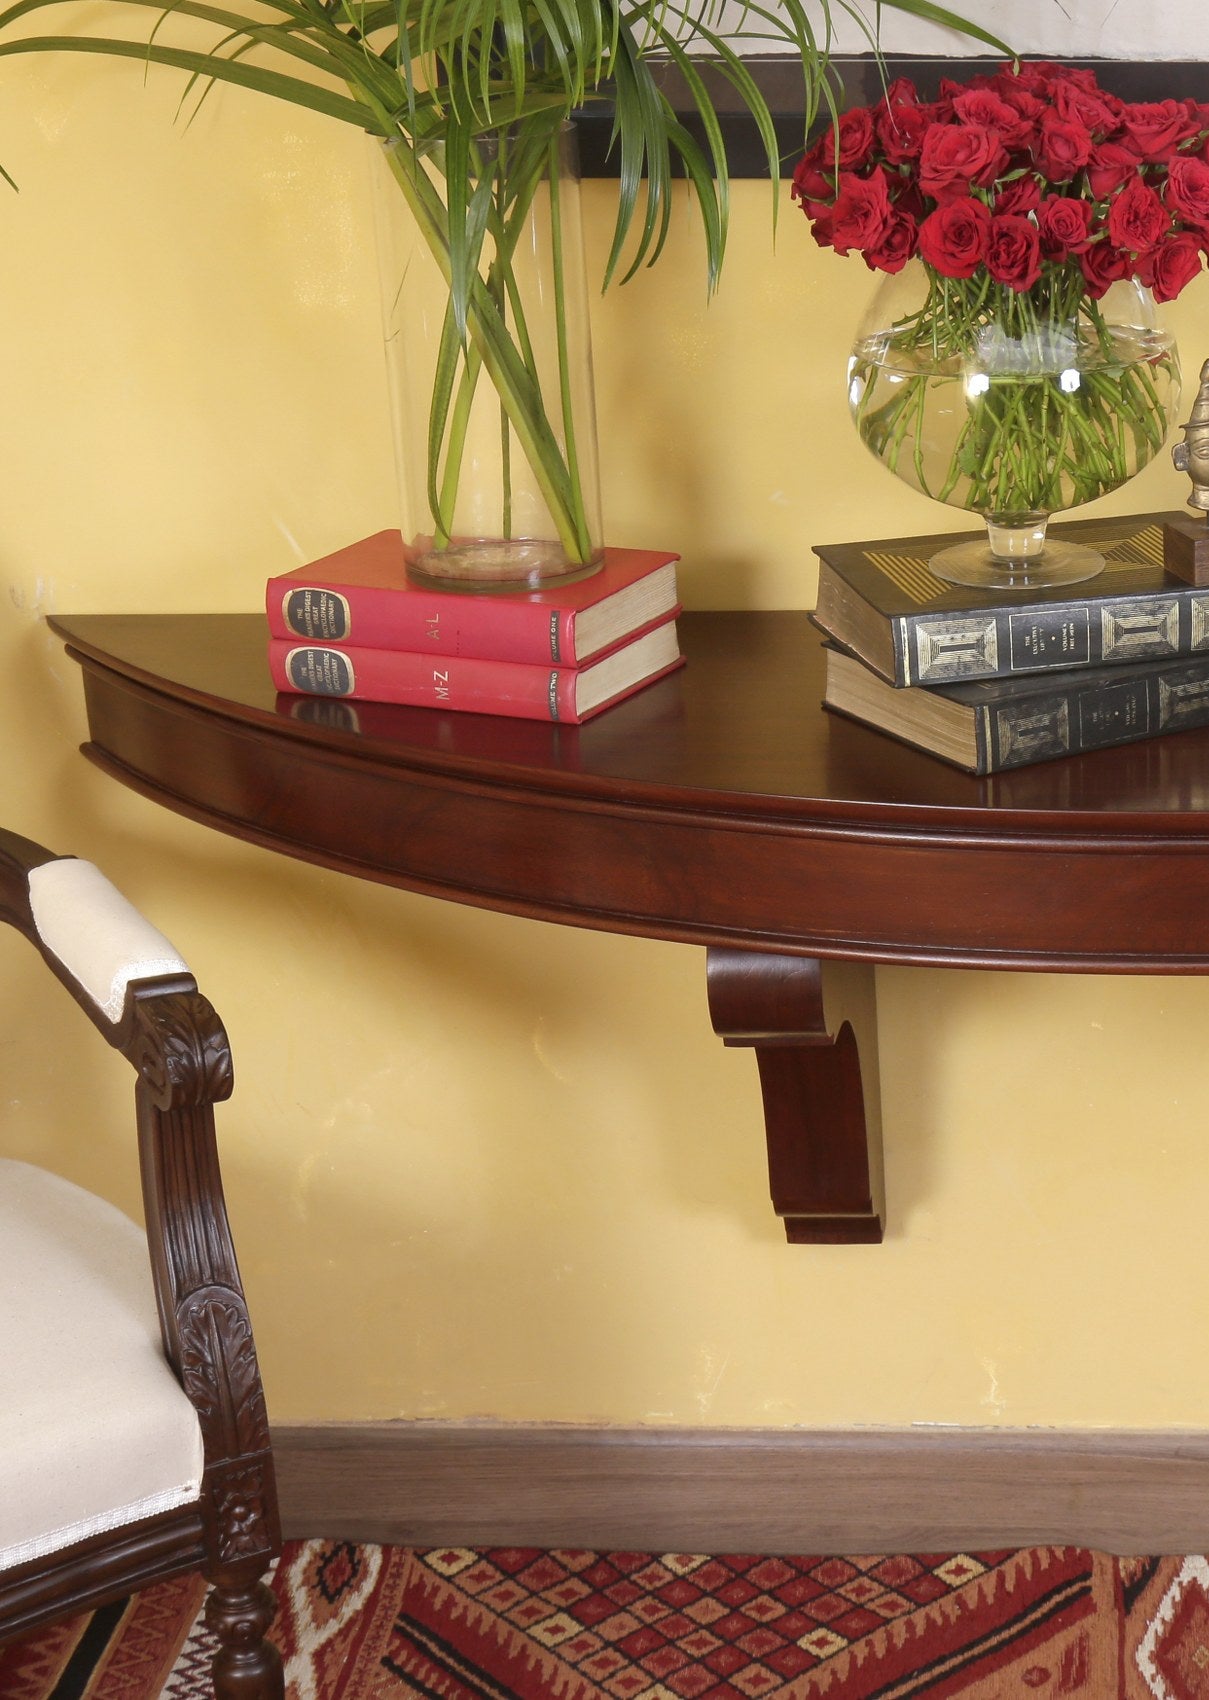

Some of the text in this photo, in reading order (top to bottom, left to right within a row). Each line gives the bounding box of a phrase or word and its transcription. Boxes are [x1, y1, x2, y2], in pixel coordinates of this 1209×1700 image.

[312, 606, 320, 624] GREAT
[433, 670, 450, 700] M-Z
[549, 672, 557, 690] TWO
